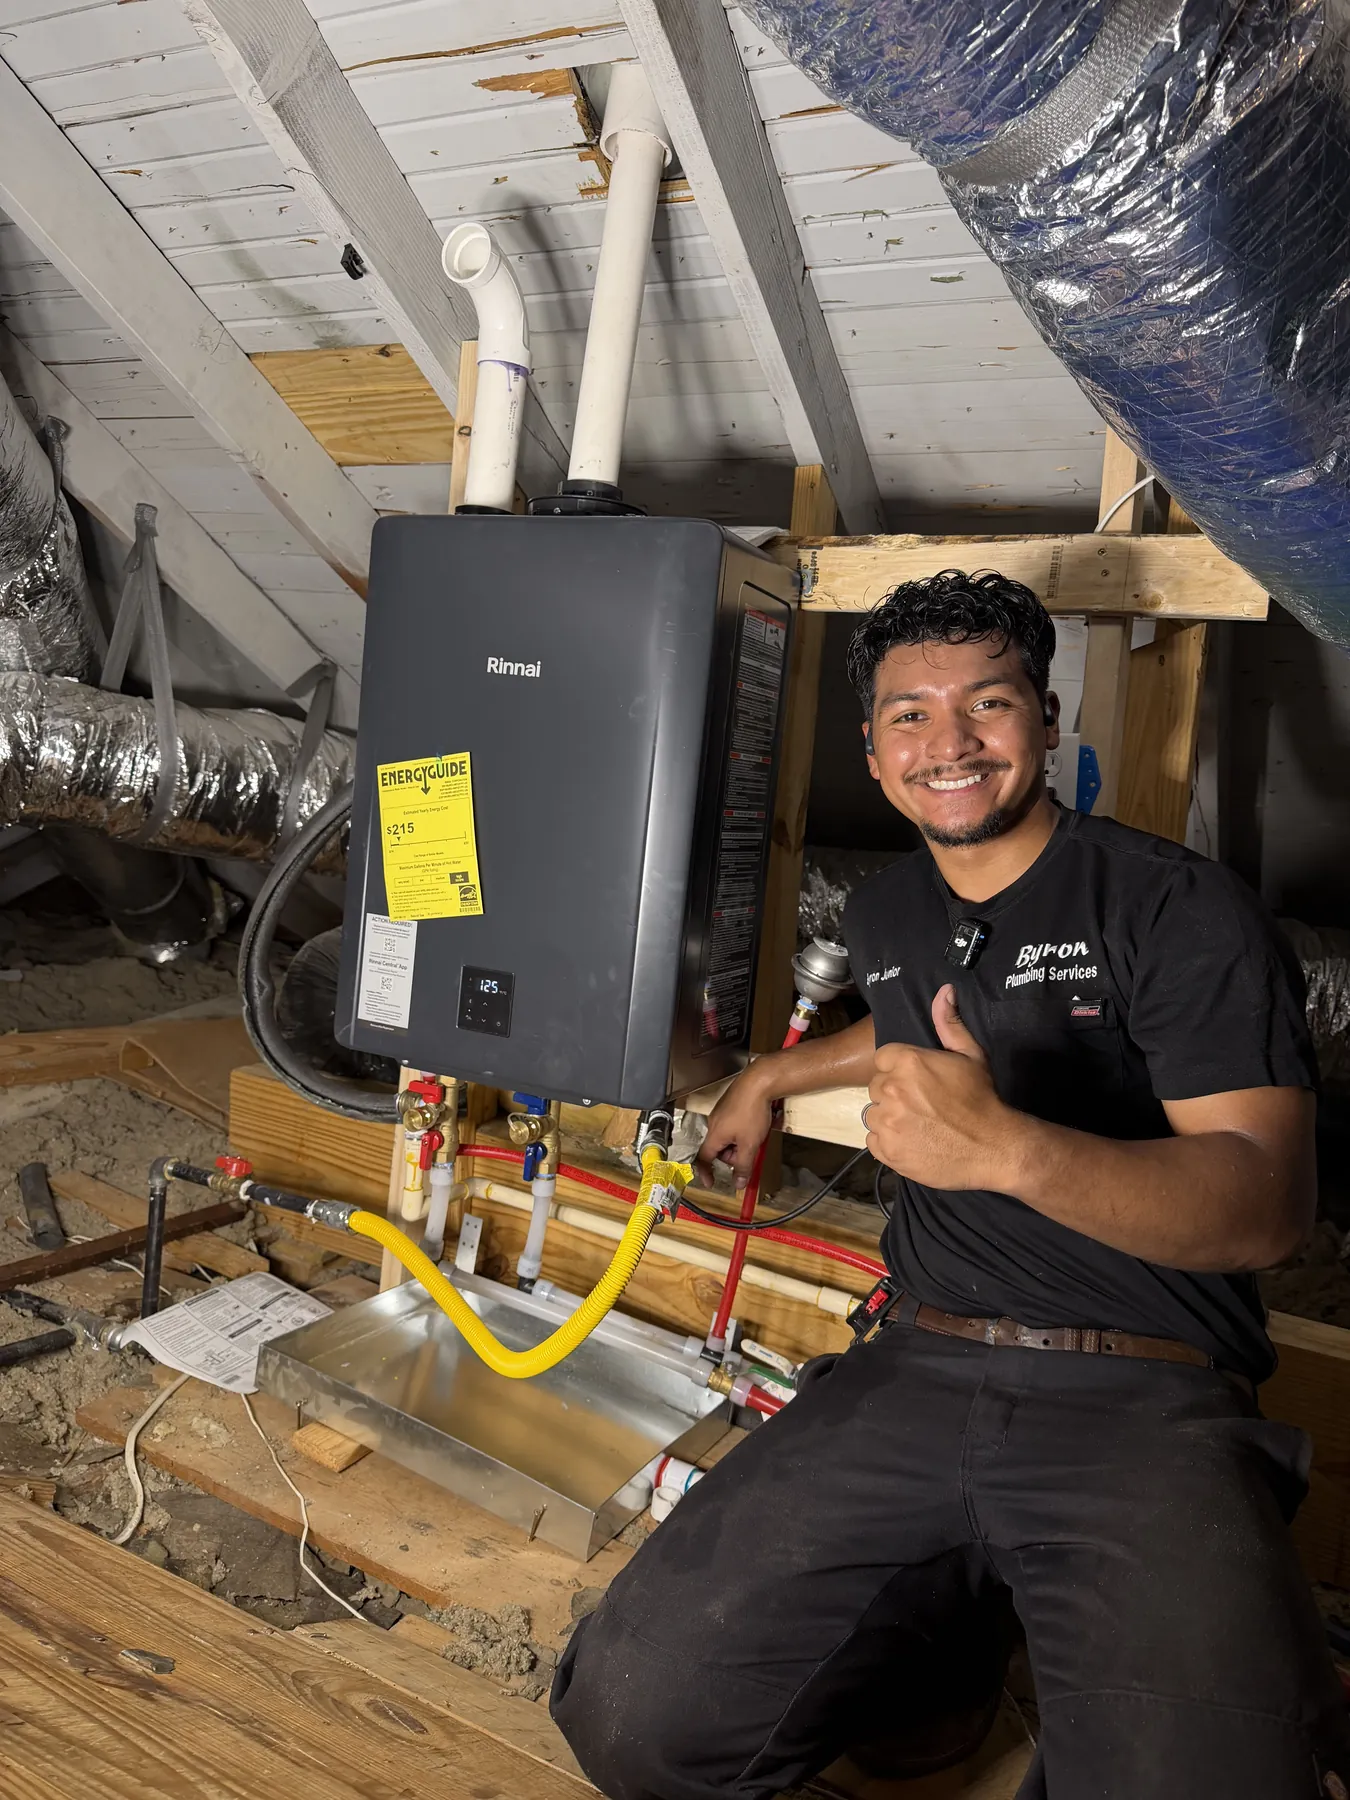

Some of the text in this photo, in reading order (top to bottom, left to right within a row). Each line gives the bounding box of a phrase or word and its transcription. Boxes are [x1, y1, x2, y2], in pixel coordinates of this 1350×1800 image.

[486, 656, 542, 678] Rinnai
[381, 760, 467, 787] ENERGYGUIDE
[387, 822, 414, 836] $215
[371, 916, 388, 924] ACTION
[1014, 941, 1090, 969] Byron
[880, 965, 901, 981] Junior
[1005, 963, 1098, 989] Plumbing Services
[480, 979, 499, 994] 125
